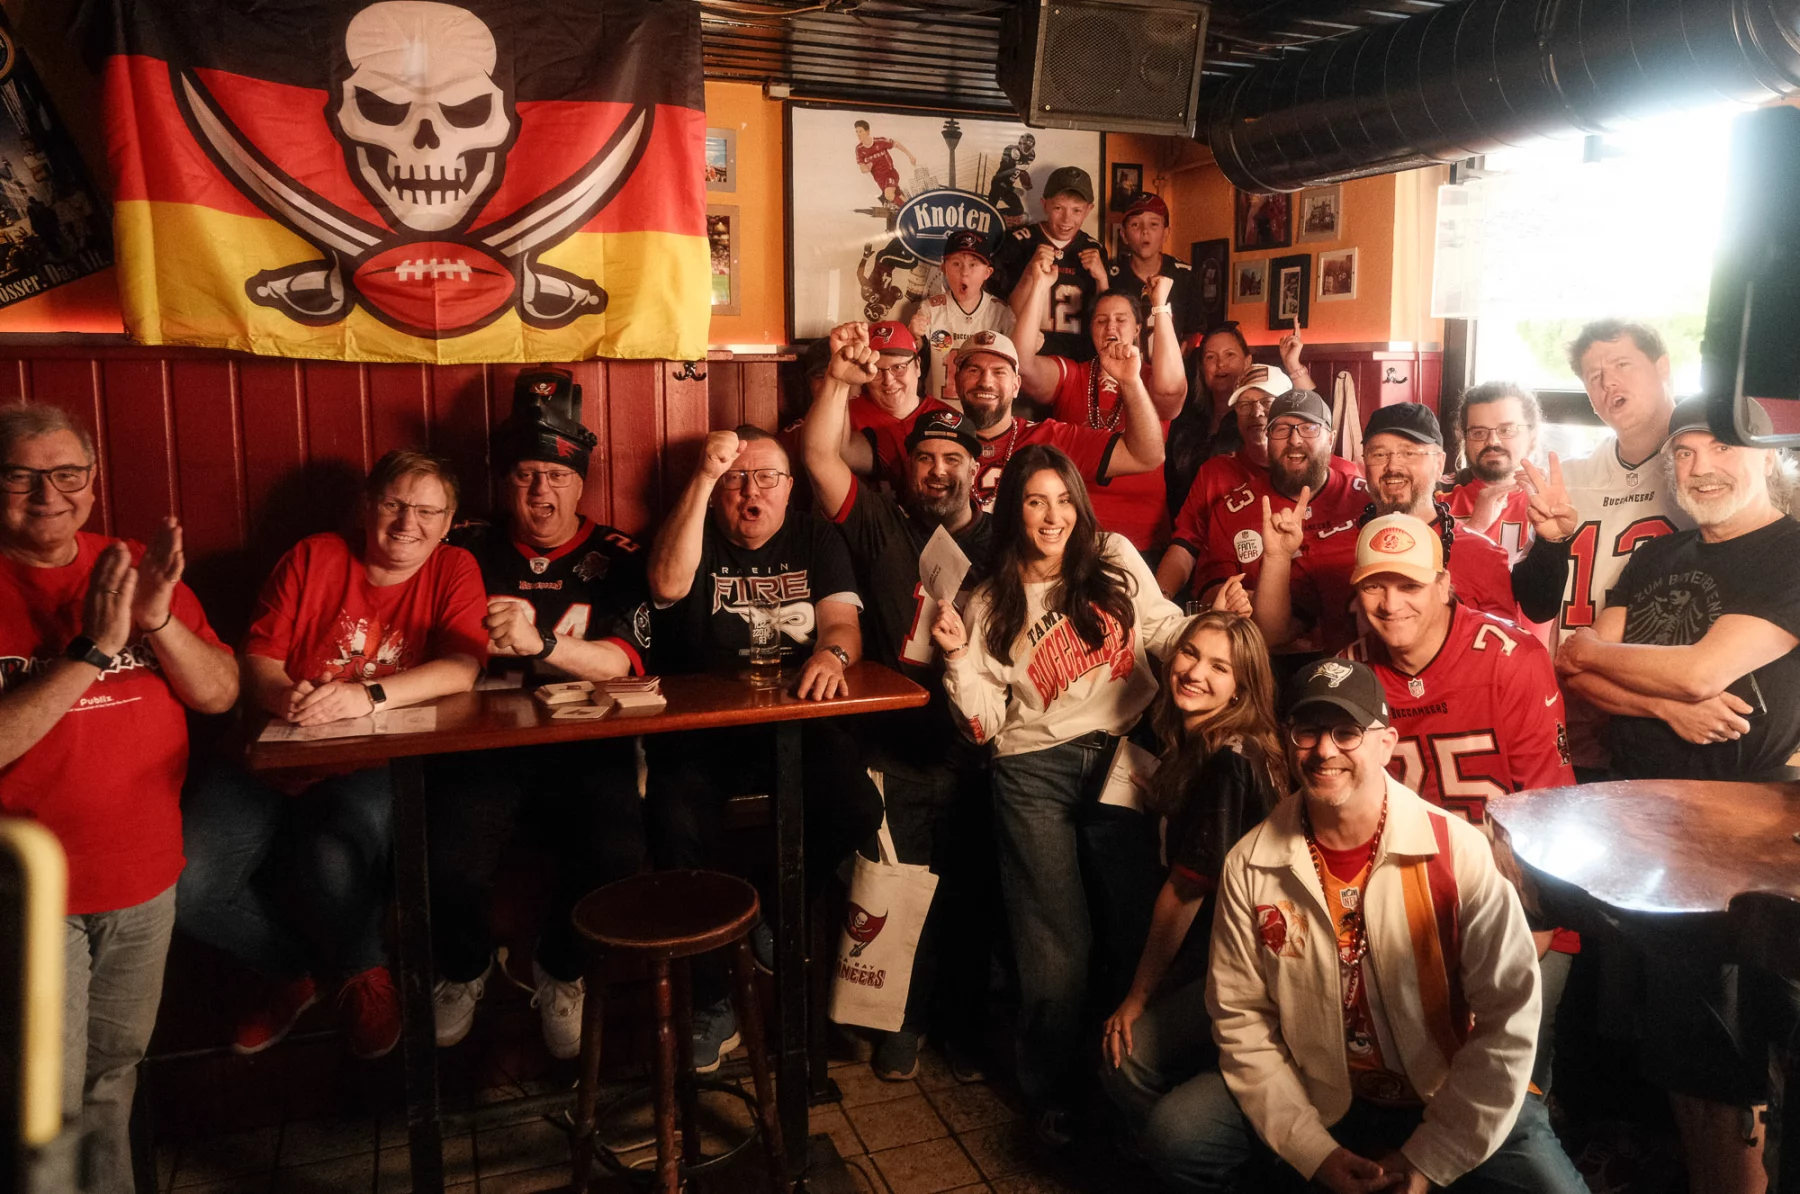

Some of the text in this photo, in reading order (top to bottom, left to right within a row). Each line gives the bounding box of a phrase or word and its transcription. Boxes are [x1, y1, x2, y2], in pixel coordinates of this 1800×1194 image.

[914, 202, 991, 233] Knoten
[1239, 550, 1258, 560] YEAR
[722, 563, 788, 574] REIN
[710, 569, 811, 615] FIRE
